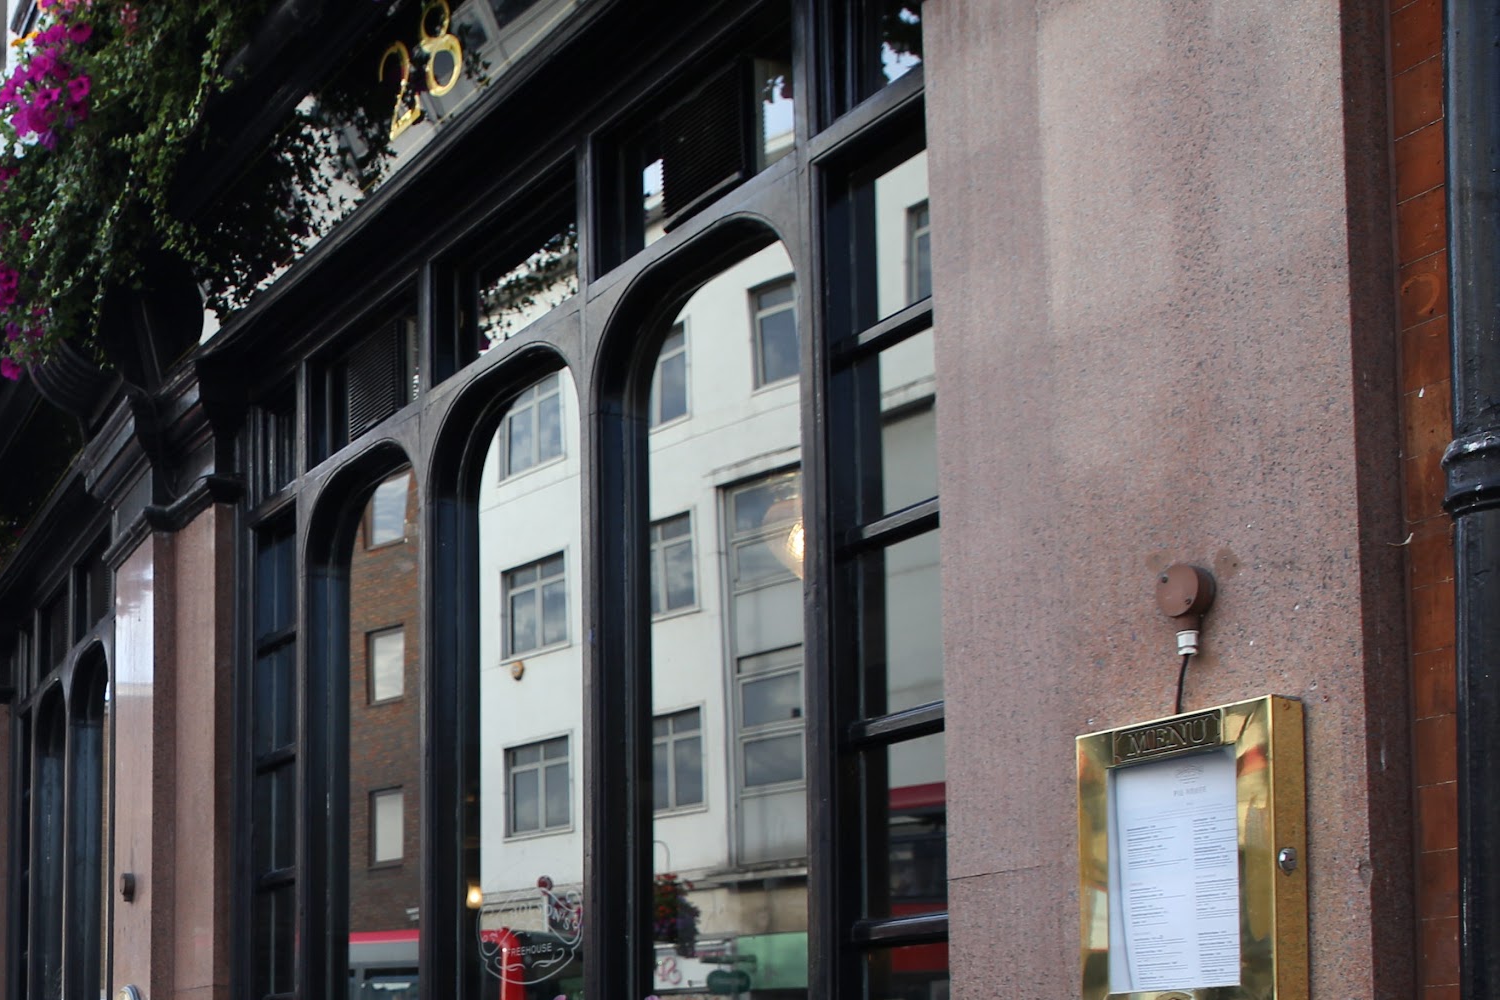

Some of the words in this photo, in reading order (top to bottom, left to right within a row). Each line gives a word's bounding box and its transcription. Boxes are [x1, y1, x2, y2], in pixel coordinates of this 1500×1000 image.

[378, 0, 463, 141] 28
[1126, 716, 1210, 757] MENU
[506, 942, 553, 958] FREEHOUSE
